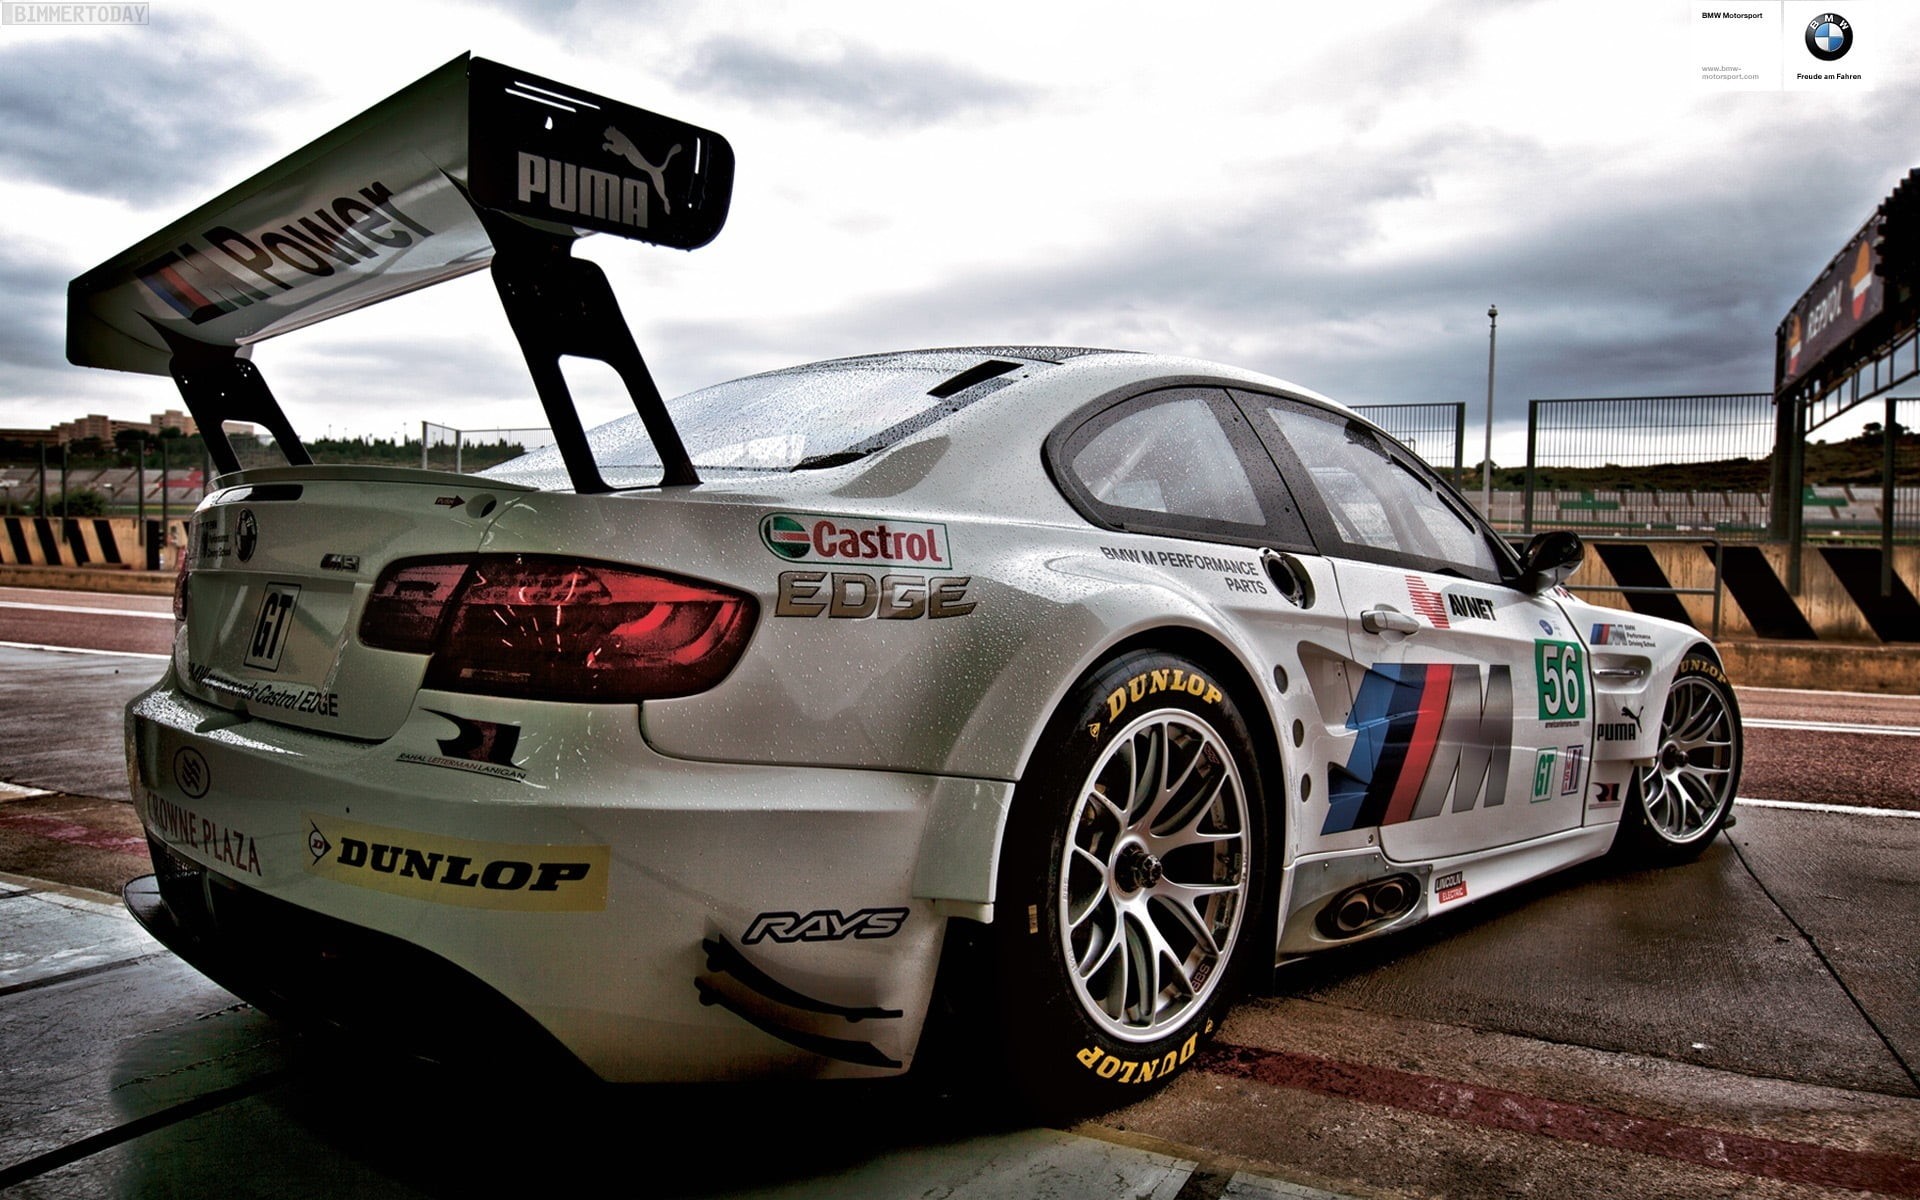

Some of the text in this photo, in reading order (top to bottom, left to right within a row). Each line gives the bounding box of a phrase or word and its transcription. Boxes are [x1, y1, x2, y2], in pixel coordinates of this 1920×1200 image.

[518, 151, 648, 228] PUMA
[202, 181, 435, 291] Power
[812, 520, 943, 562] Castrol
[1100, 546, 1259, 576] BMW M PERFORMANCE
[774, 570, 978, 620] EDGE
[1225, 577, 1268, 595] PARTS
[1448, 593, 1497, 621] AVNET
[252, 592, 294, 659] GT
[256, 684, 300, 710] Castrol
[300, 690, 339, 717] EDGE
[1107, 668, 1223, 723] DUNLOP
[1542, 643, 1580, 715] 56
[1597, 723, 1636, 741] PUMA
[427, 755, 478, 771] LETTERMAN
[478, 765, 527, 780] LANIGAN
[1535, 753, 1555, 797] GT
[202, 818, 263, 877] PLAZA
[337, 837, 591, 891] DUNLOP
[740, 906, 910, 945] RAYS
[1076, 1032, 1199, 1083] DUNLOP
